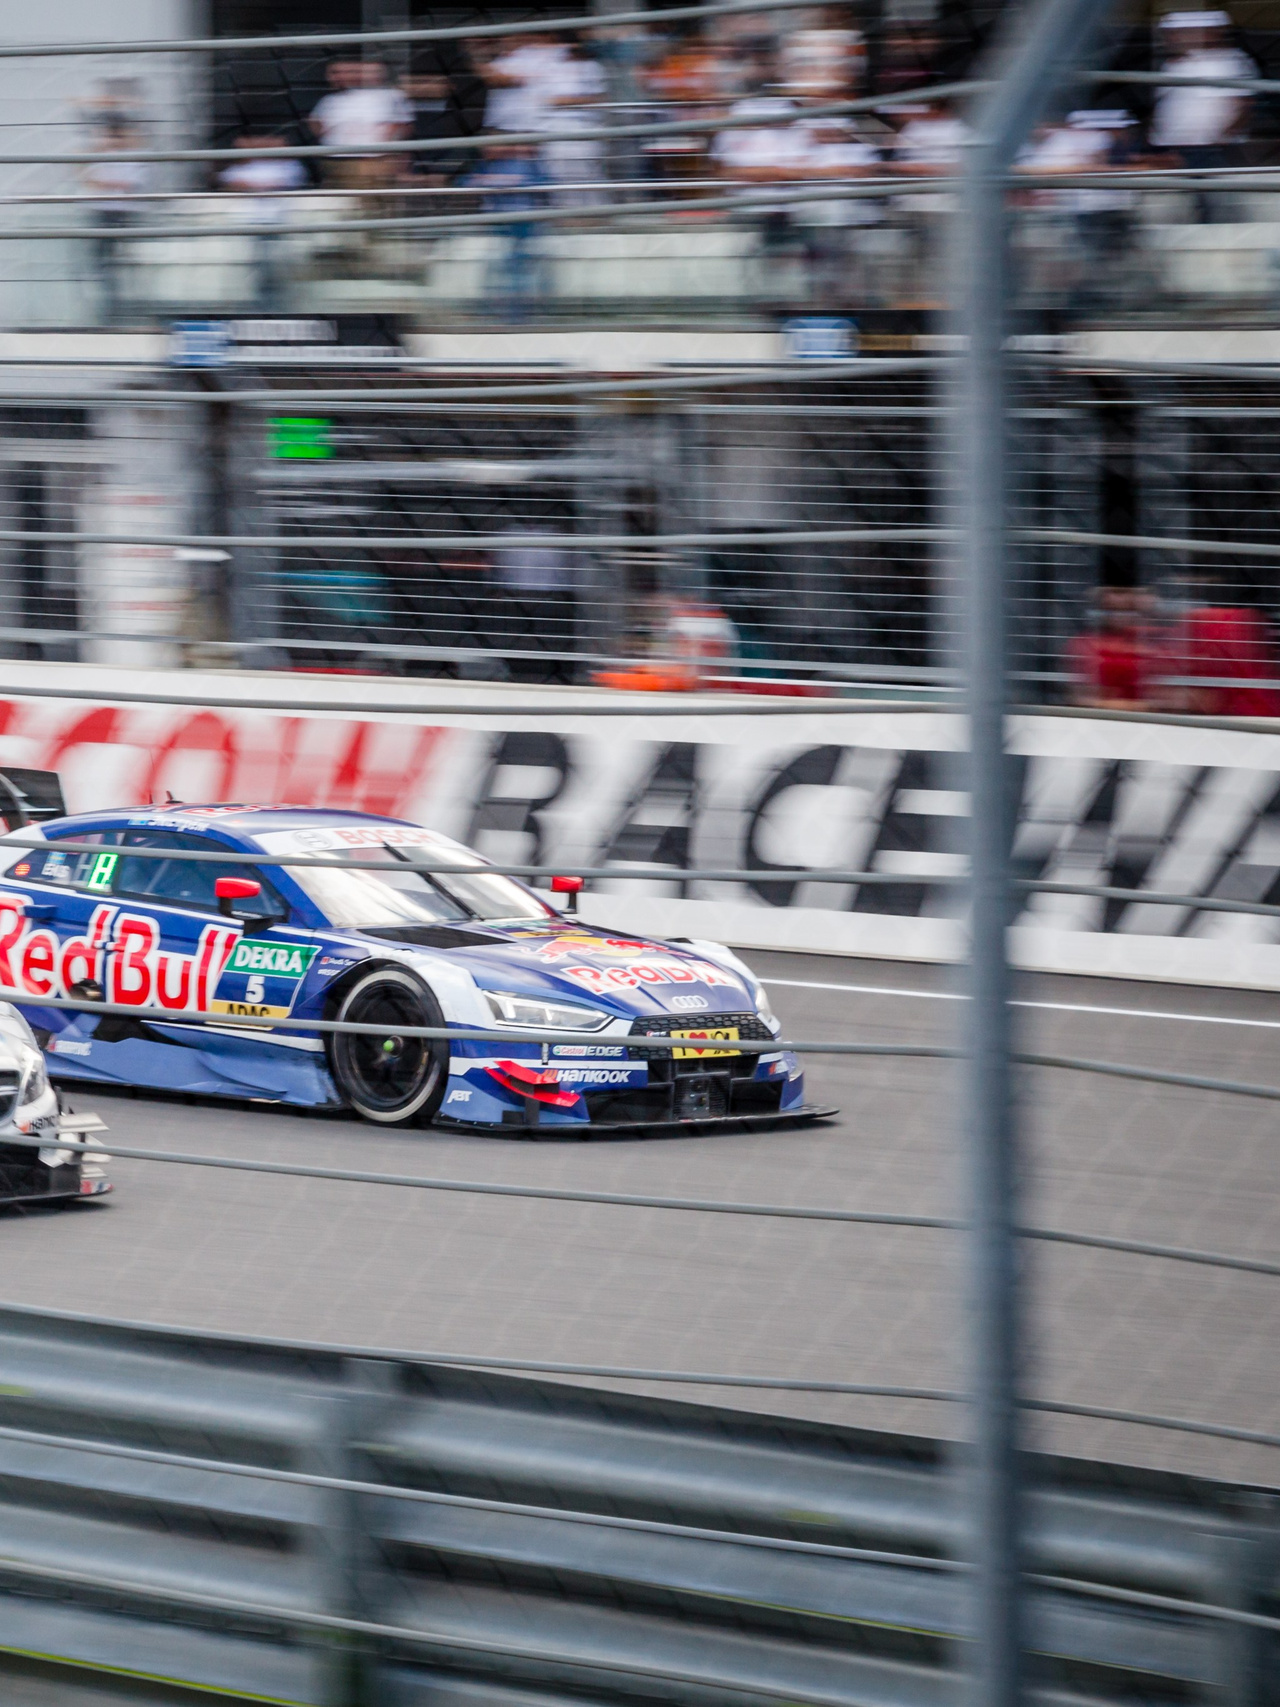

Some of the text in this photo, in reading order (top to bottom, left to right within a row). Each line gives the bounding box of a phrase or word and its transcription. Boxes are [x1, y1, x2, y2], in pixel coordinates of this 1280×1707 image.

[334, 829, 440, 845] BOSCH
[111, 915, 241, 1013] Bull
[234, 944, 303, 973] DEKRA
[245, 975, 265, 1003] 5
[586, 1046, 624, 1057] EDGE
